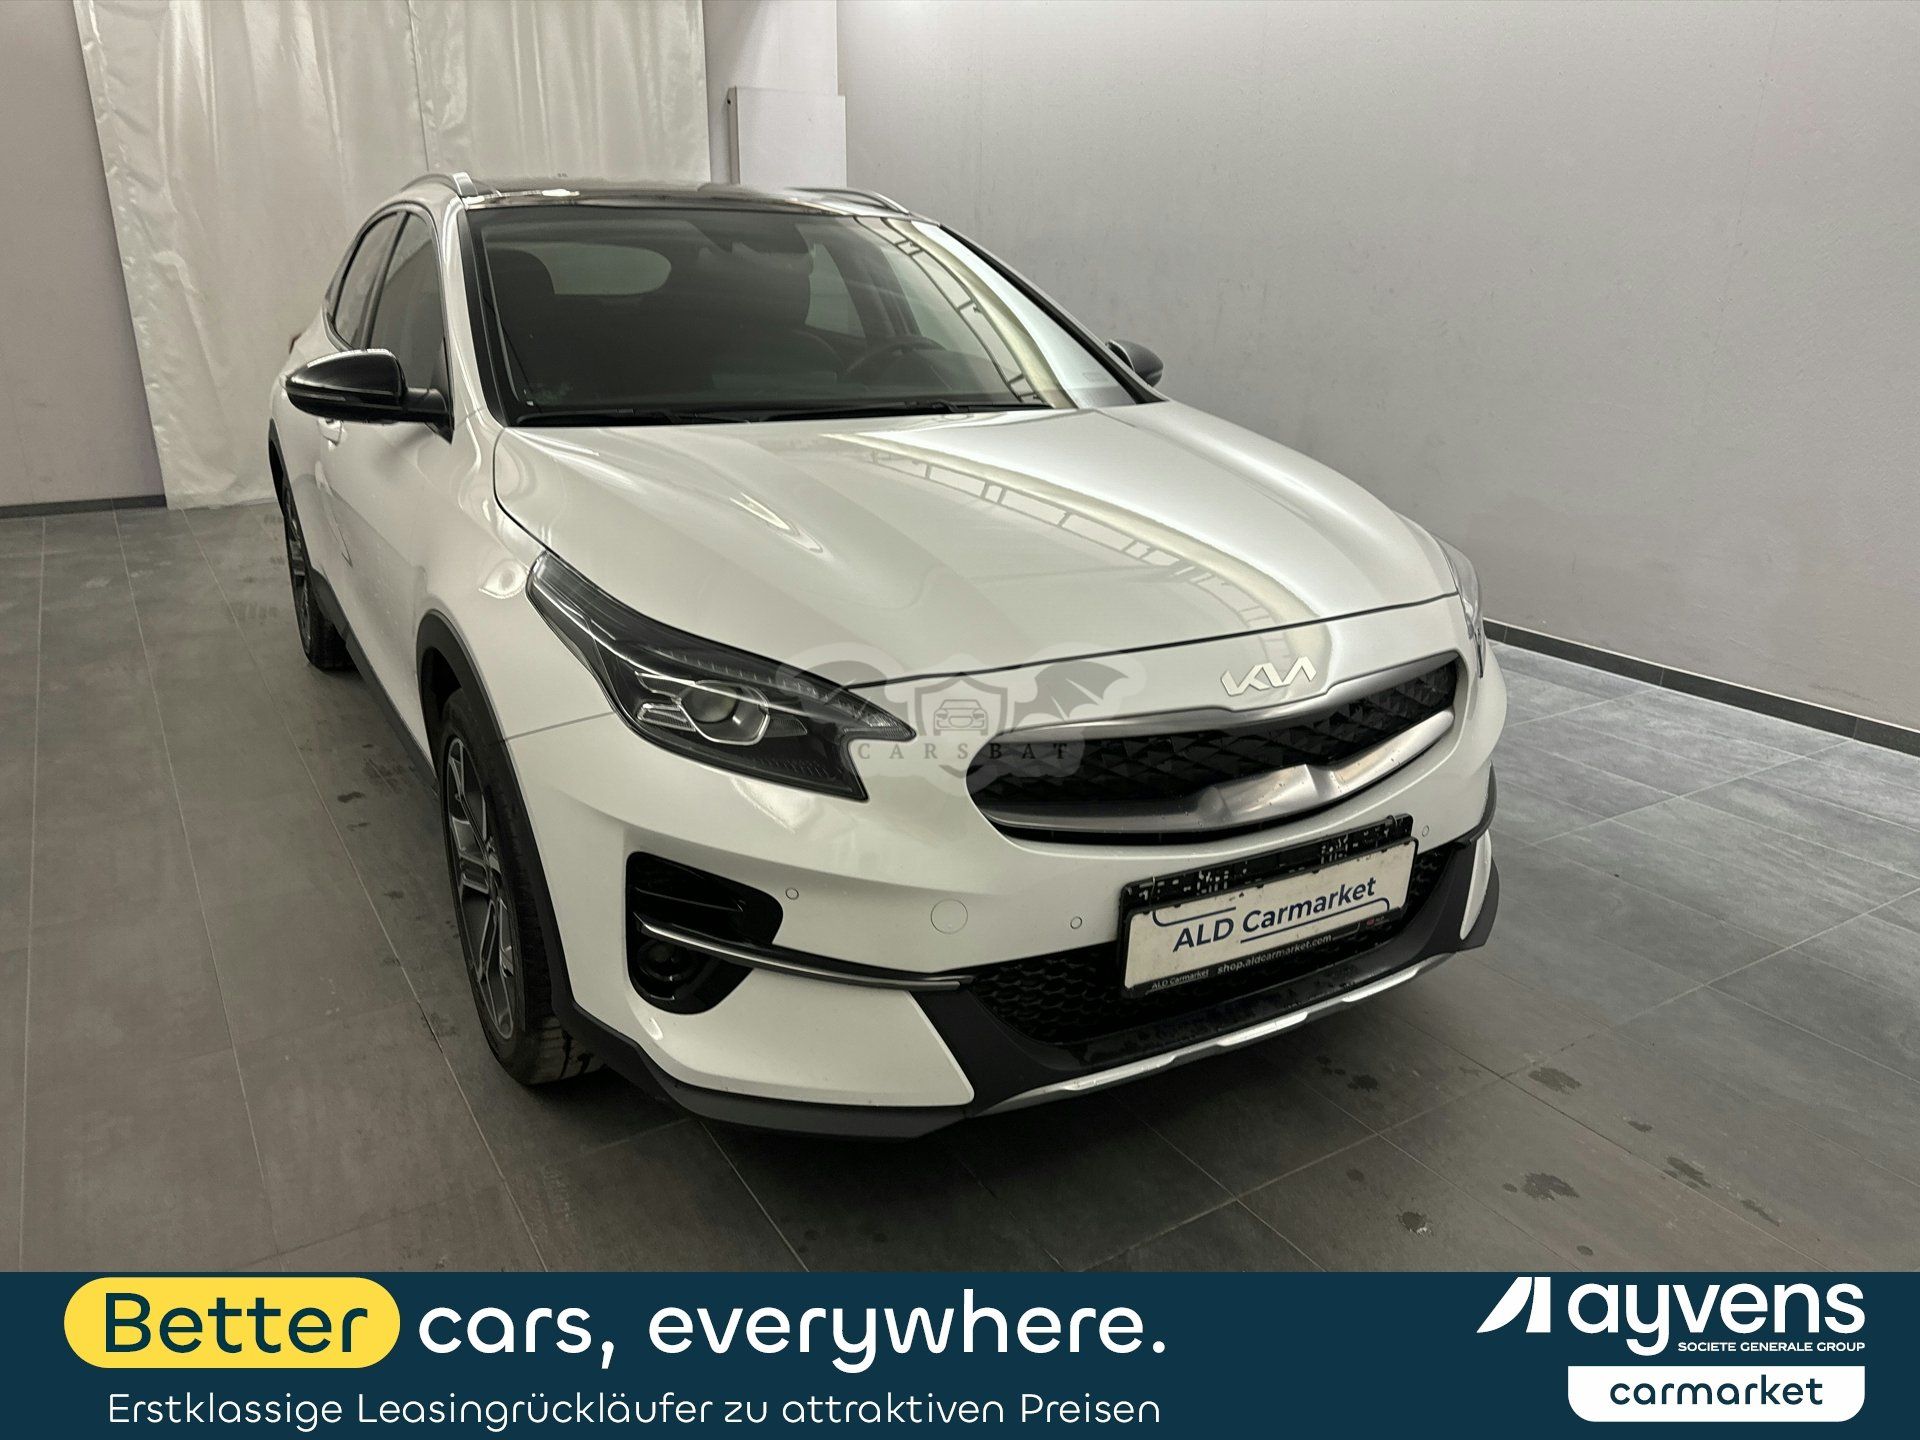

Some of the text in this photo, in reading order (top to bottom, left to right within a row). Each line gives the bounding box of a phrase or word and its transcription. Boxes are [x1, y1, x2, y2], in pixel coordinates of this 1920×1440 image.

[1221, 656, 1317, 697] KIA
[1172, 876, 1377, 953] ALD Carmarket
[1217, 934, 1333, 975] shop.aldcarmarket.com
[1151, 969, 1210, 990] ALD Carmarket
